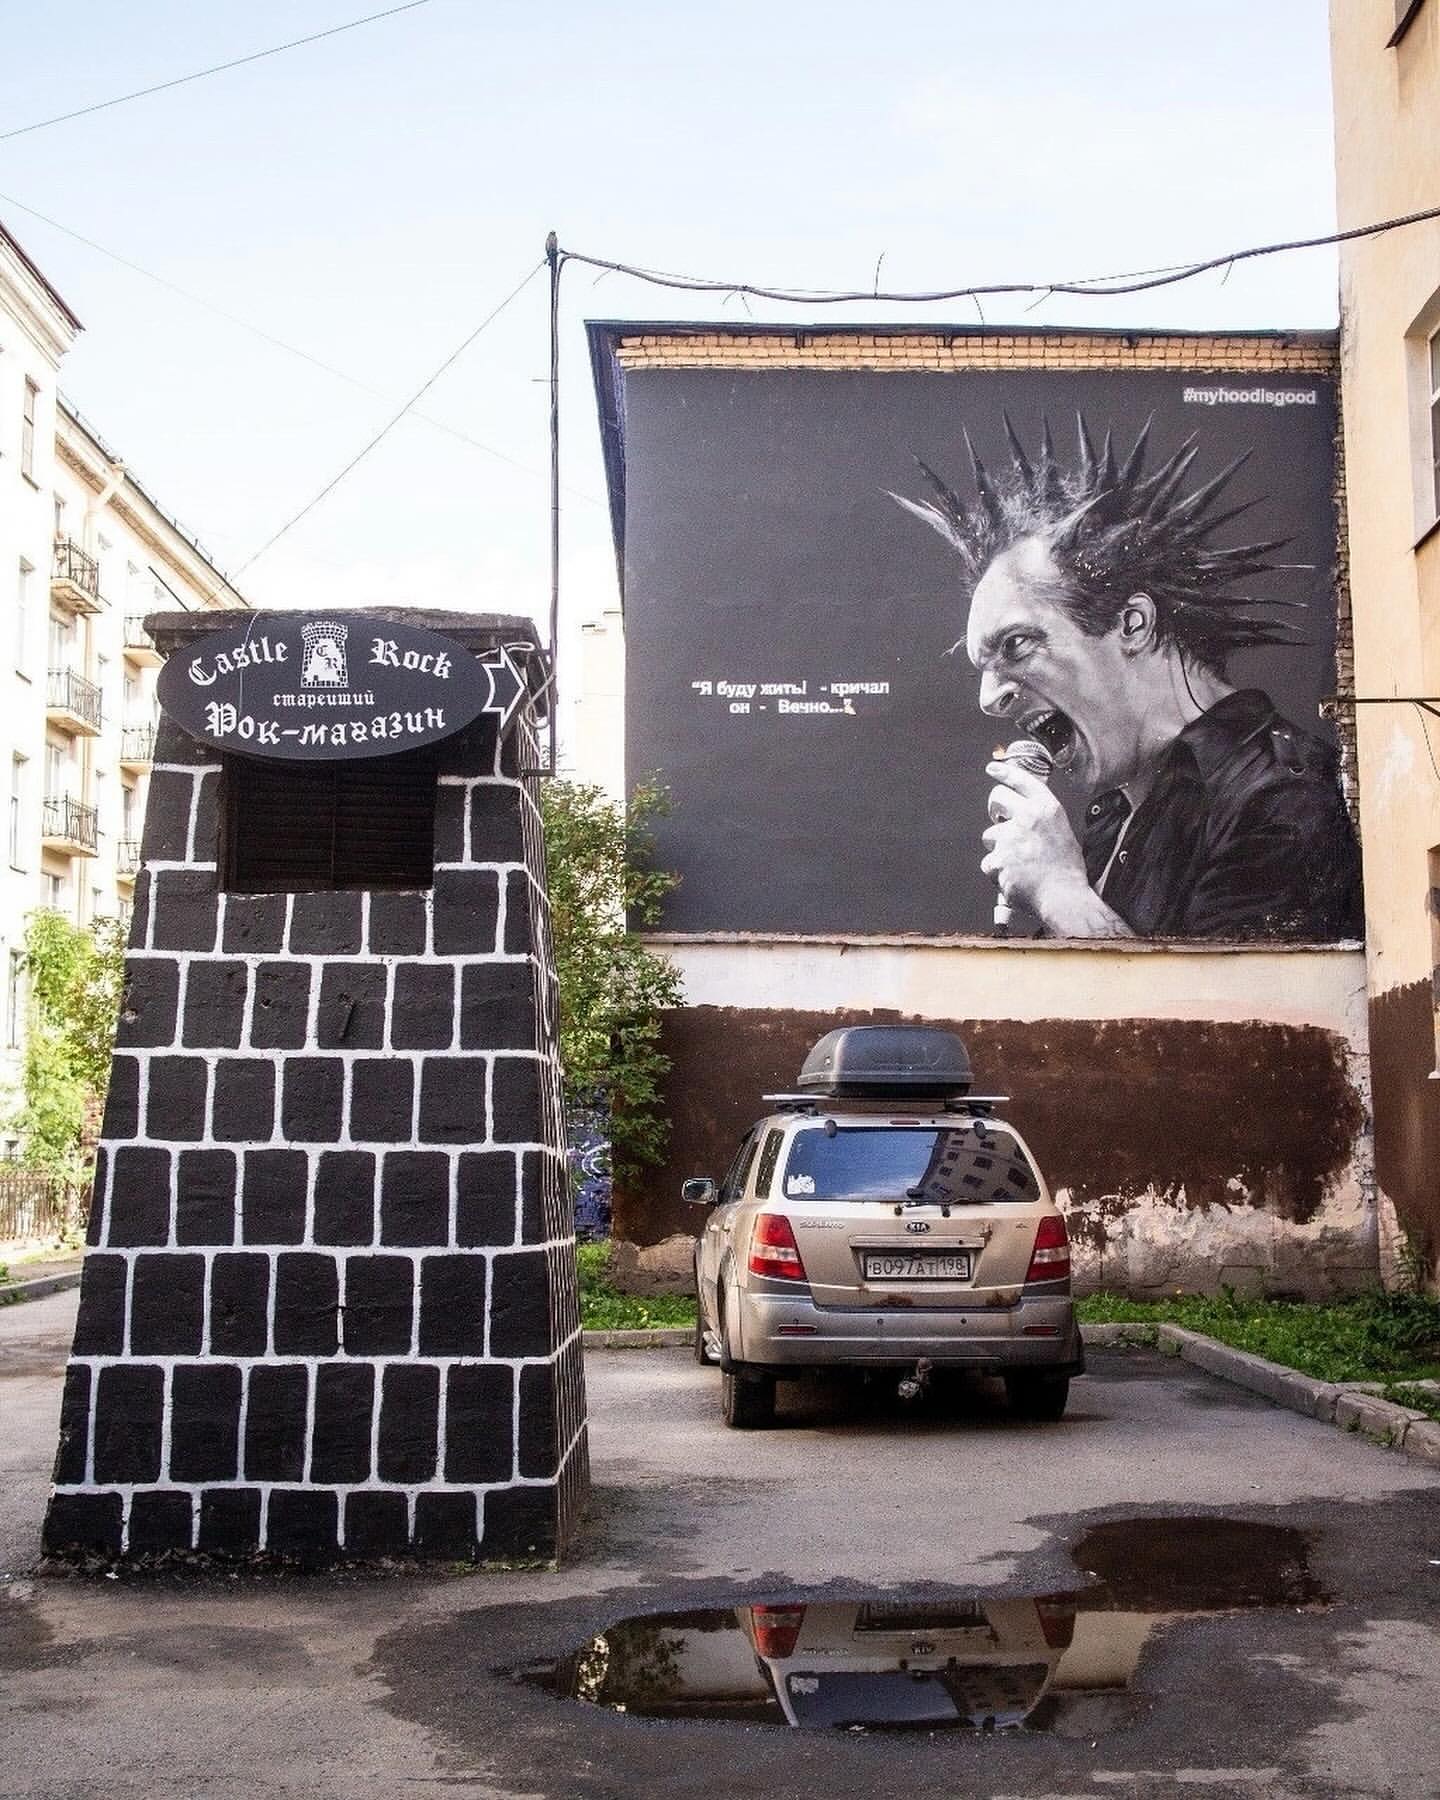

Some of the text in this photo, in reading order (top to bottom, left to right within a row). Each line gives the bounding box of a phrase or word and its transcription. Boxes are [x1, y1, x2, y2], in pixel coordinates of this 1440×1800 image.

[1183, 388, 1316, 406] #myhoodisgood
[188, 636, 452, 686] Castle Rock
[717, 680, 756, 698] буду
[760, 680, 807, 695] жить!
[831, 682, 890, 697] кричал
[729, 702, 750, 714] он
[204, 701, 446, 746] Рок-магазин
